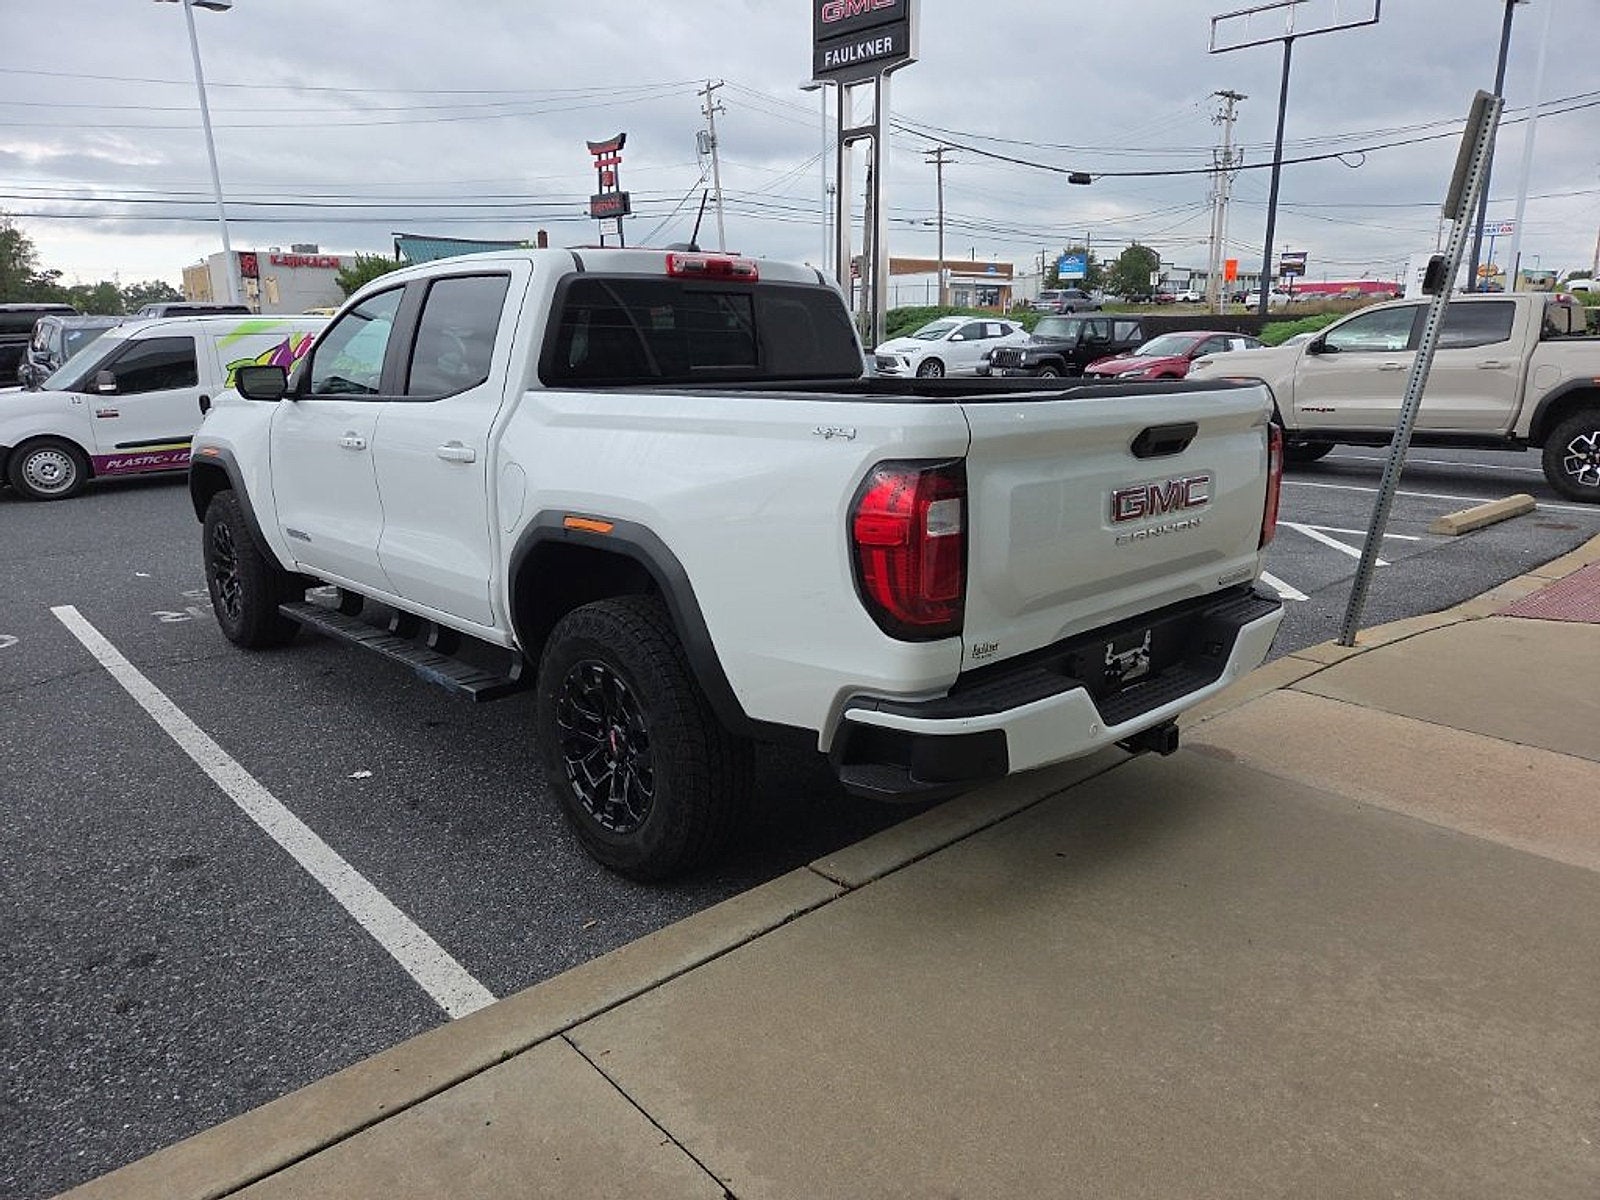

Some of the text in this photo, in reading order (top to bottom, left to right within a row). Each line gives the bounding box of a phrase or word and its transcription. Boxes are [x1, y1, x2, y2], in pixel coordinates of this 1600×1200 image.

[824, 37, 892, 67] FAULKNER
[1111, 474, 1211, 523] GMC
[1114, 517, 1204, 547] CANYON
